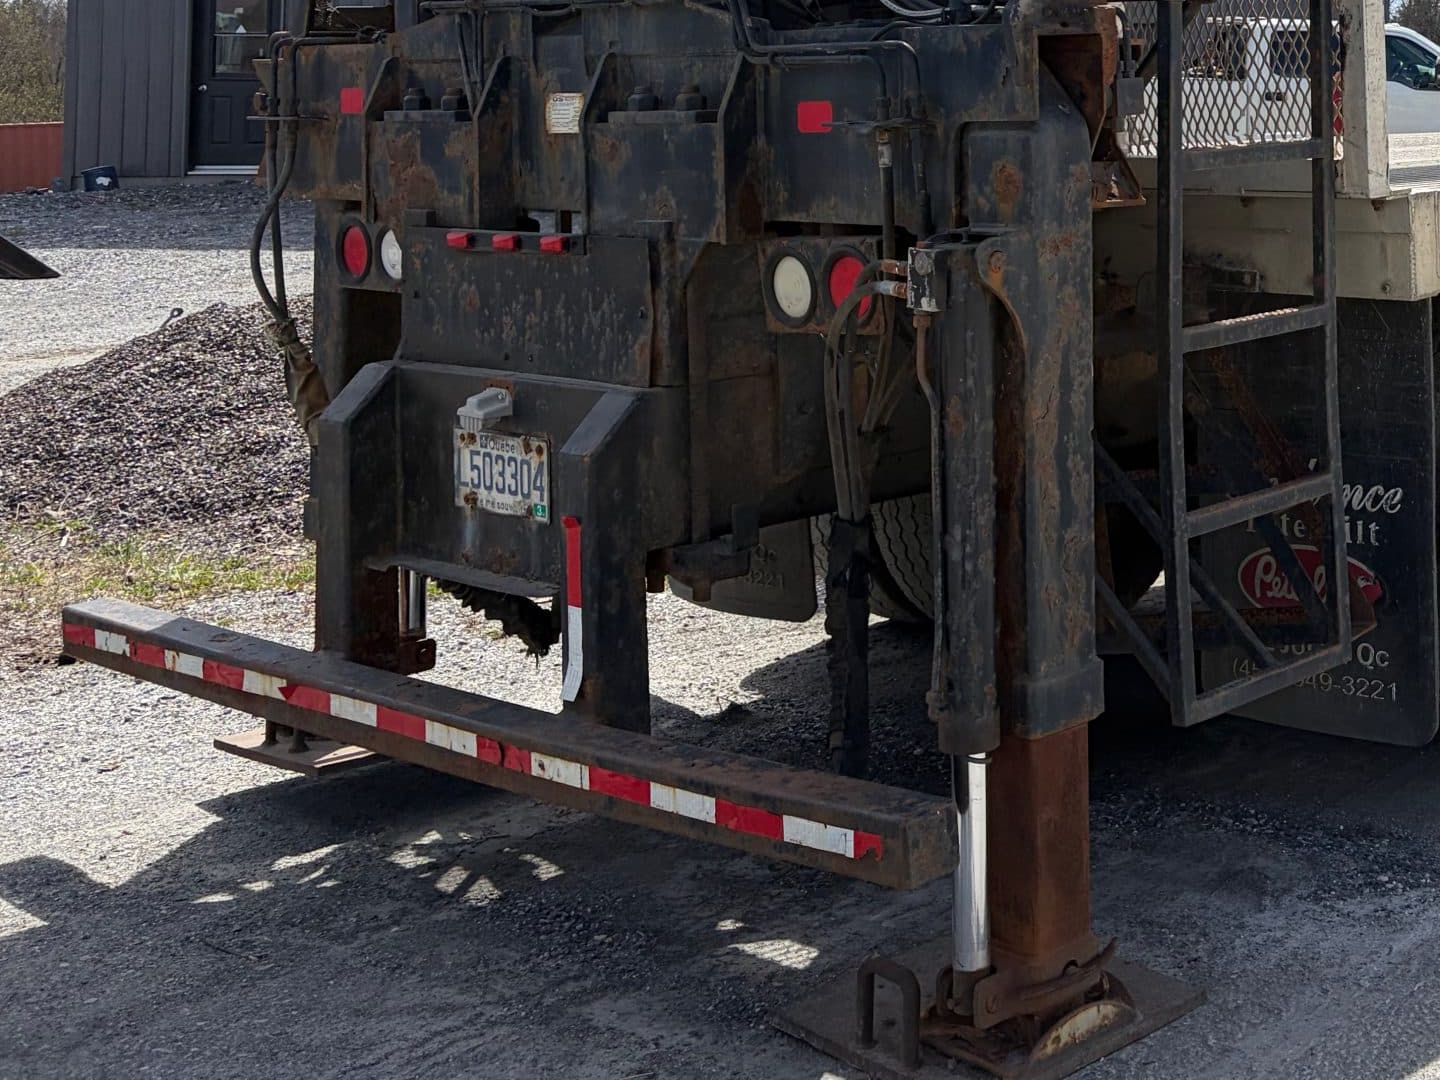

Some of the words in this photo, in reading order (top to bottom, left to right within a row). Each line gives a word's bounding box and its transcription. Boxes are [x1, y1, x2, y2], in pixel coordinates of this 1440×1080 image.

[488, 439, 520, 454] Québe
[457, 447, 545, 502] L503304
[1356, 642, 1390, 669] Qc
